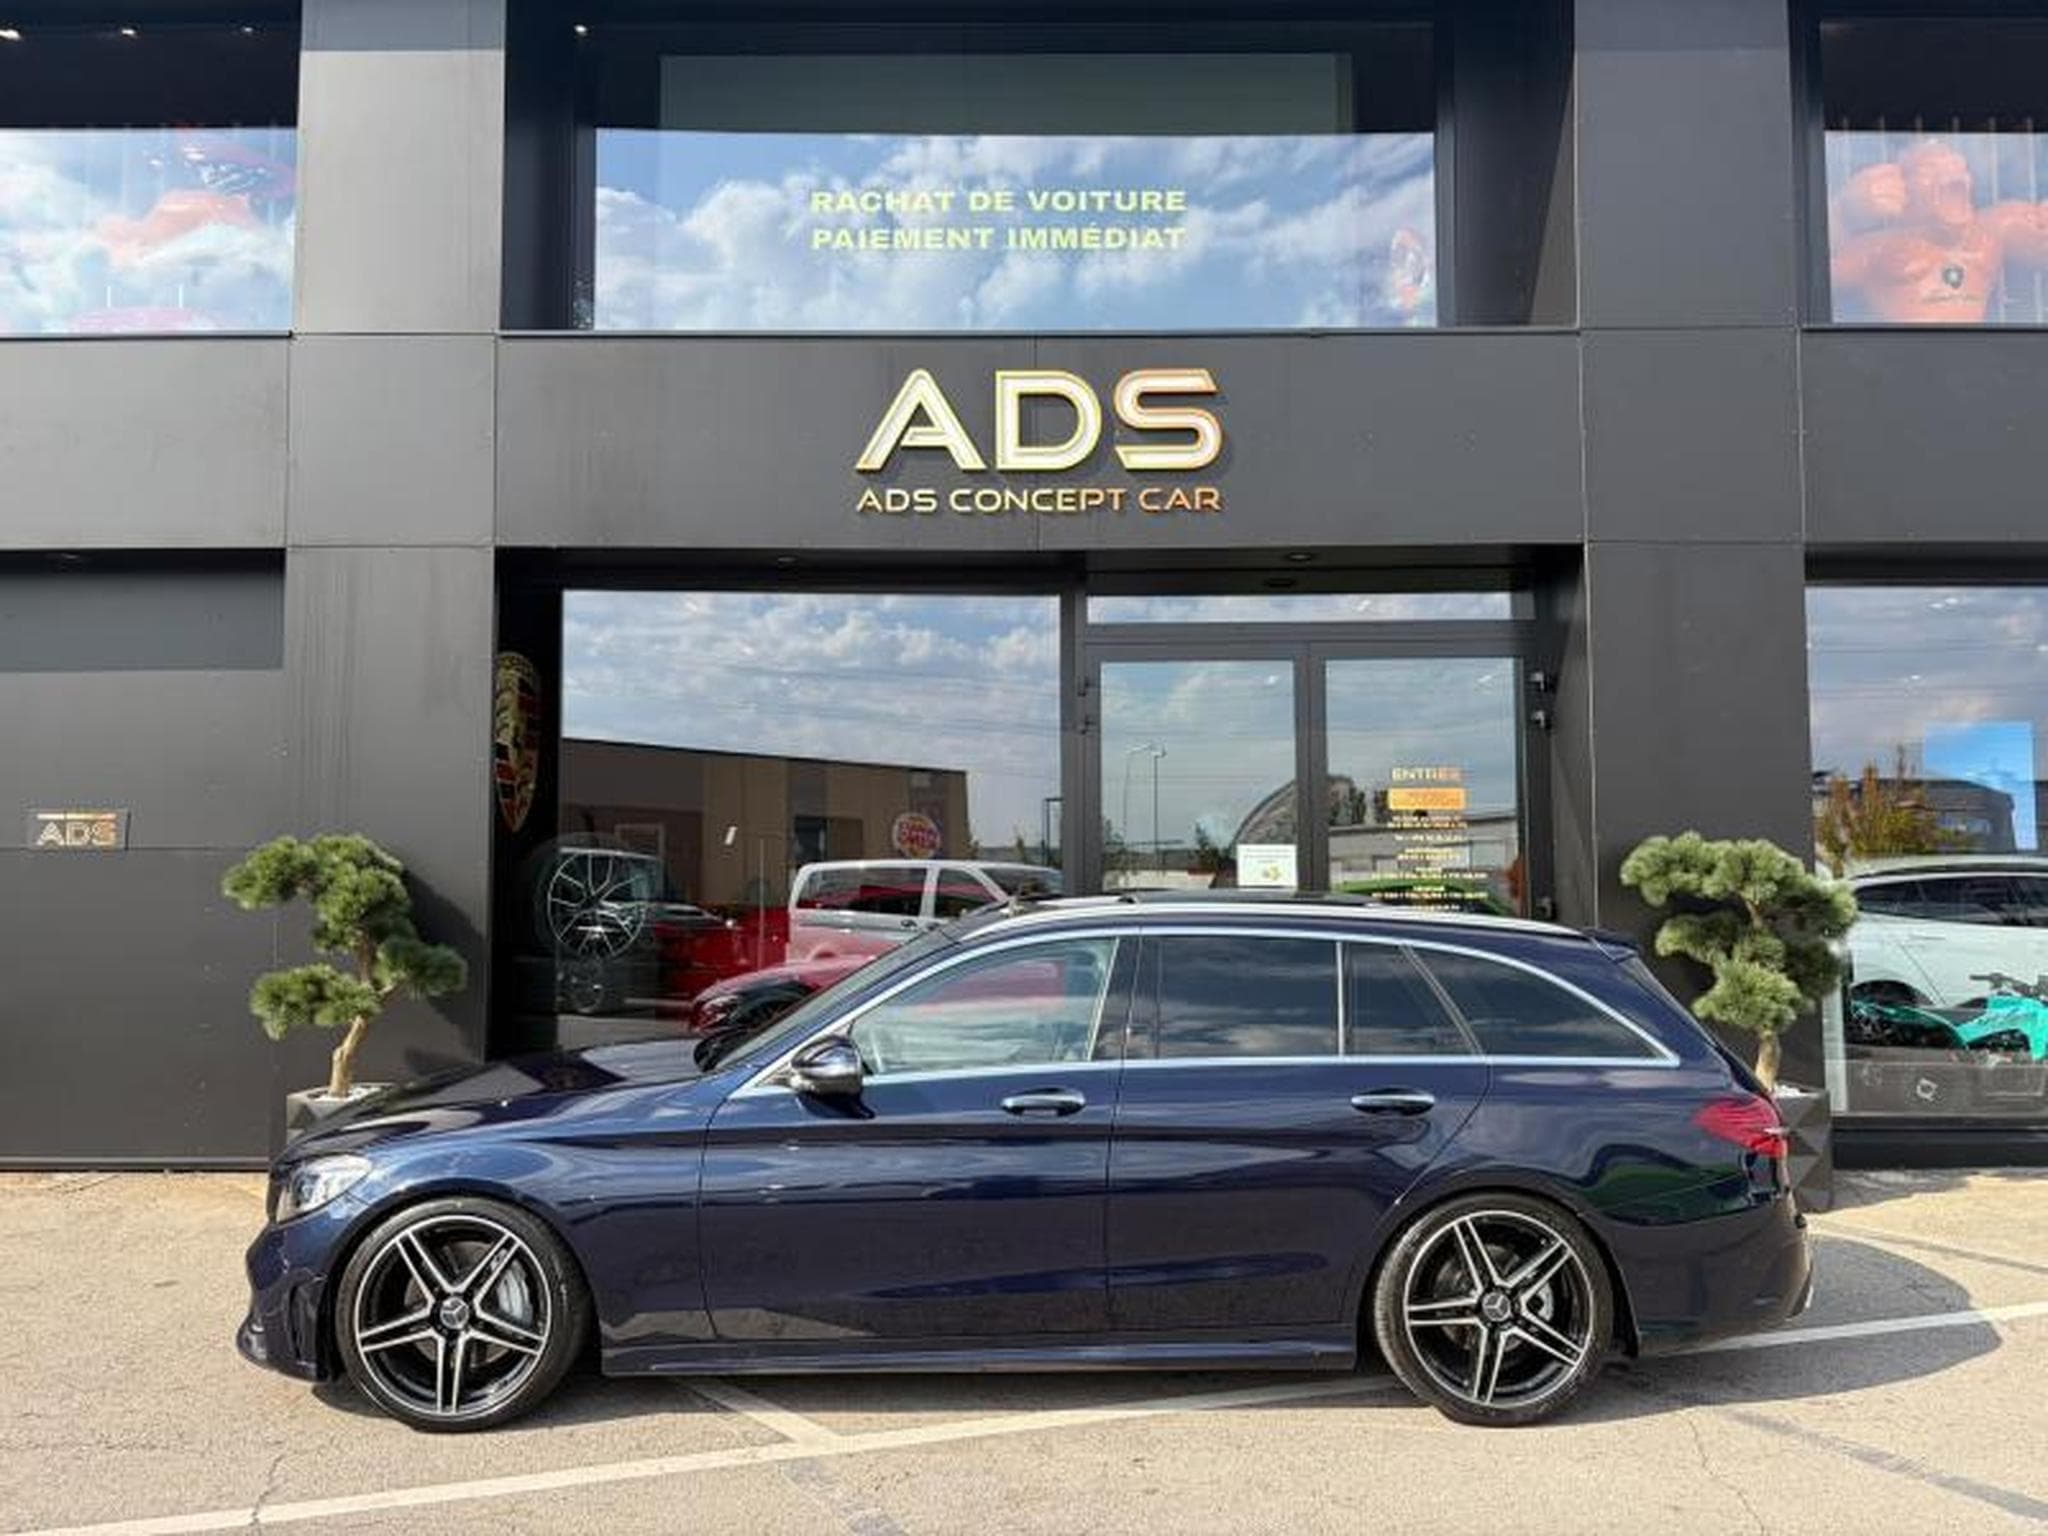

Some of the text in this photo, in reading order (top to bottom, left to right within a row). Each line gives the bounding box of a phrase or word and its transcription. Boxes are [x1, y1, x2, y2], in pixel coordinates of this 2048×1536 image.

[811, 189, 1187, 213] RACHAT DE VOITURE
[811, 221, 1187, 251] PAIEMENT IMMÉDIAT
[855, 368, 1223, 471] ADS
[856, 486, 1222, 513] ADS CONCEPT CAR
[36, 820, 117, 847] ADS
